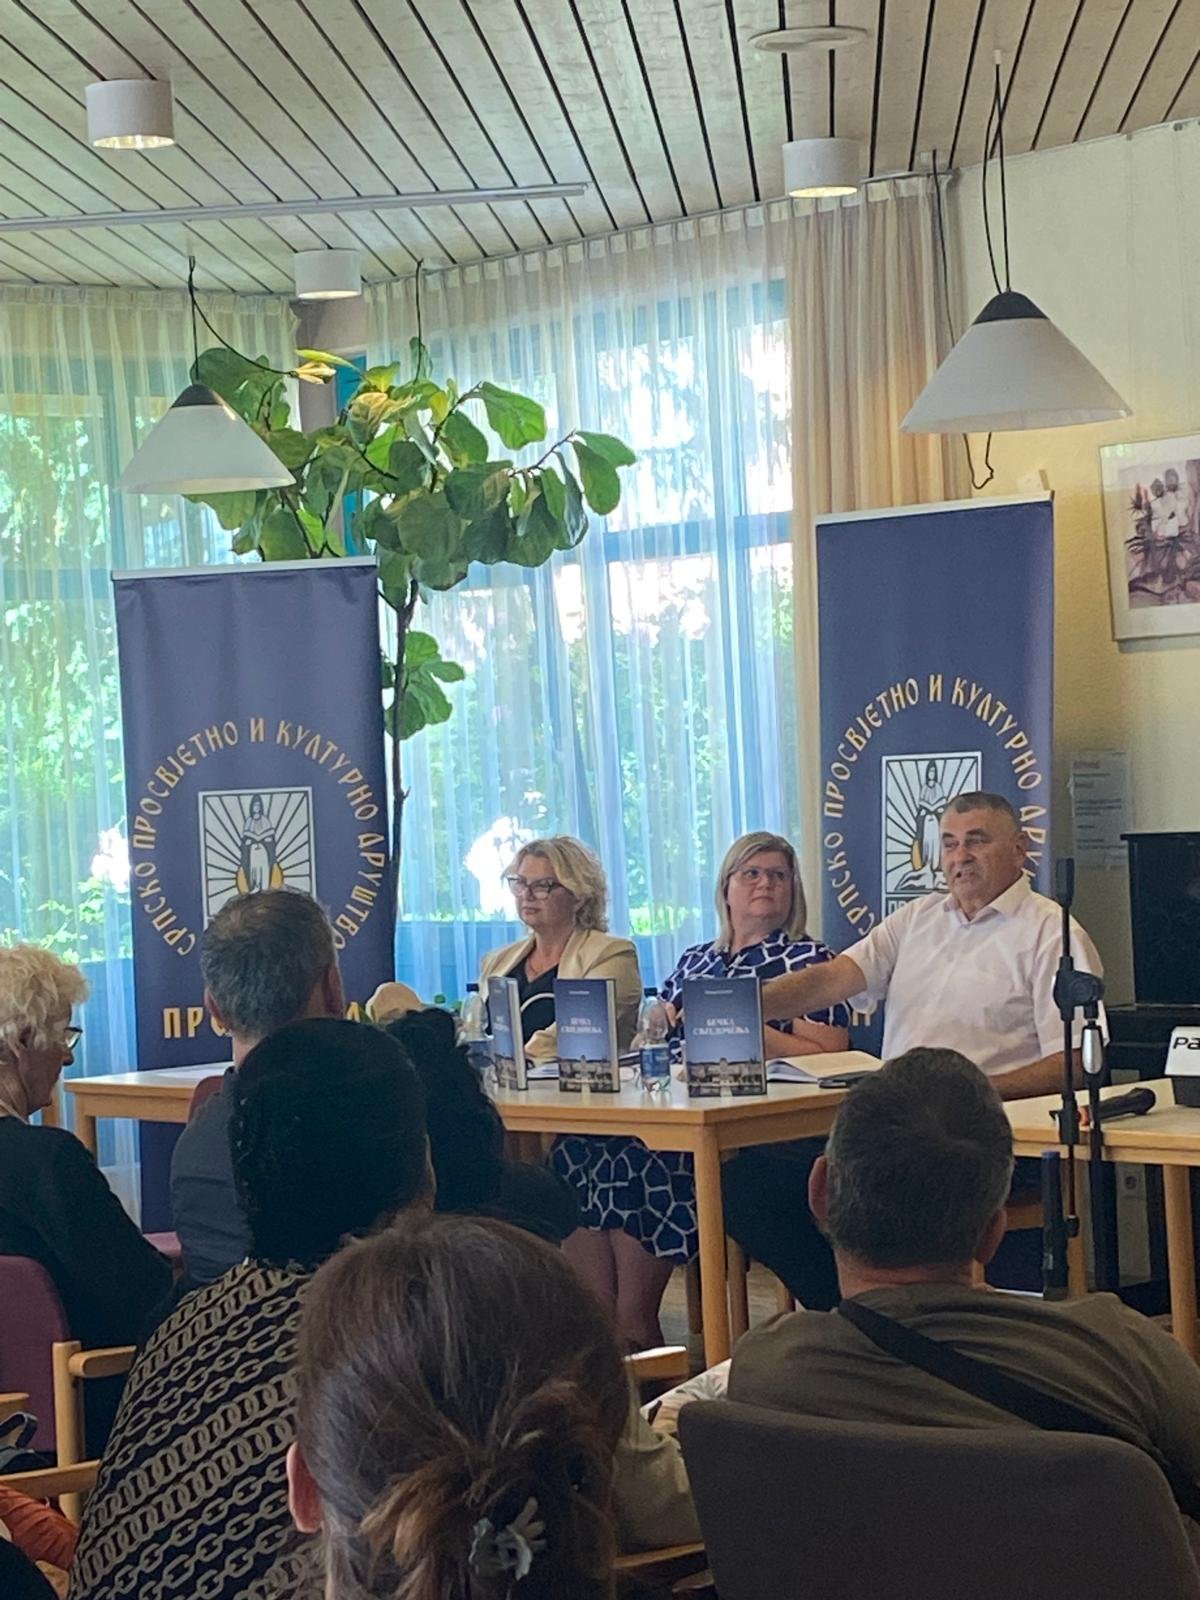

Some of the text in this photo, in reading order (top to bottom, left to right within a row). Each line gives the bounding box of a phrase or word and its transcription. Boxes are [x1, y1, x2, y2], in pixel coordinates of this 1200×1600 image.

[250, 717, 265, 742] И
[276, 720, 379, 821] КУЛТУРНО
[132, 721, 239, 850] ПРОСВЈЕТНО
[824, 674, 1042, 936] СРПСКО ПРОСВЈЕТНО И КУЛТУРНО
[134, 862, 196, 956] СРПСКО
